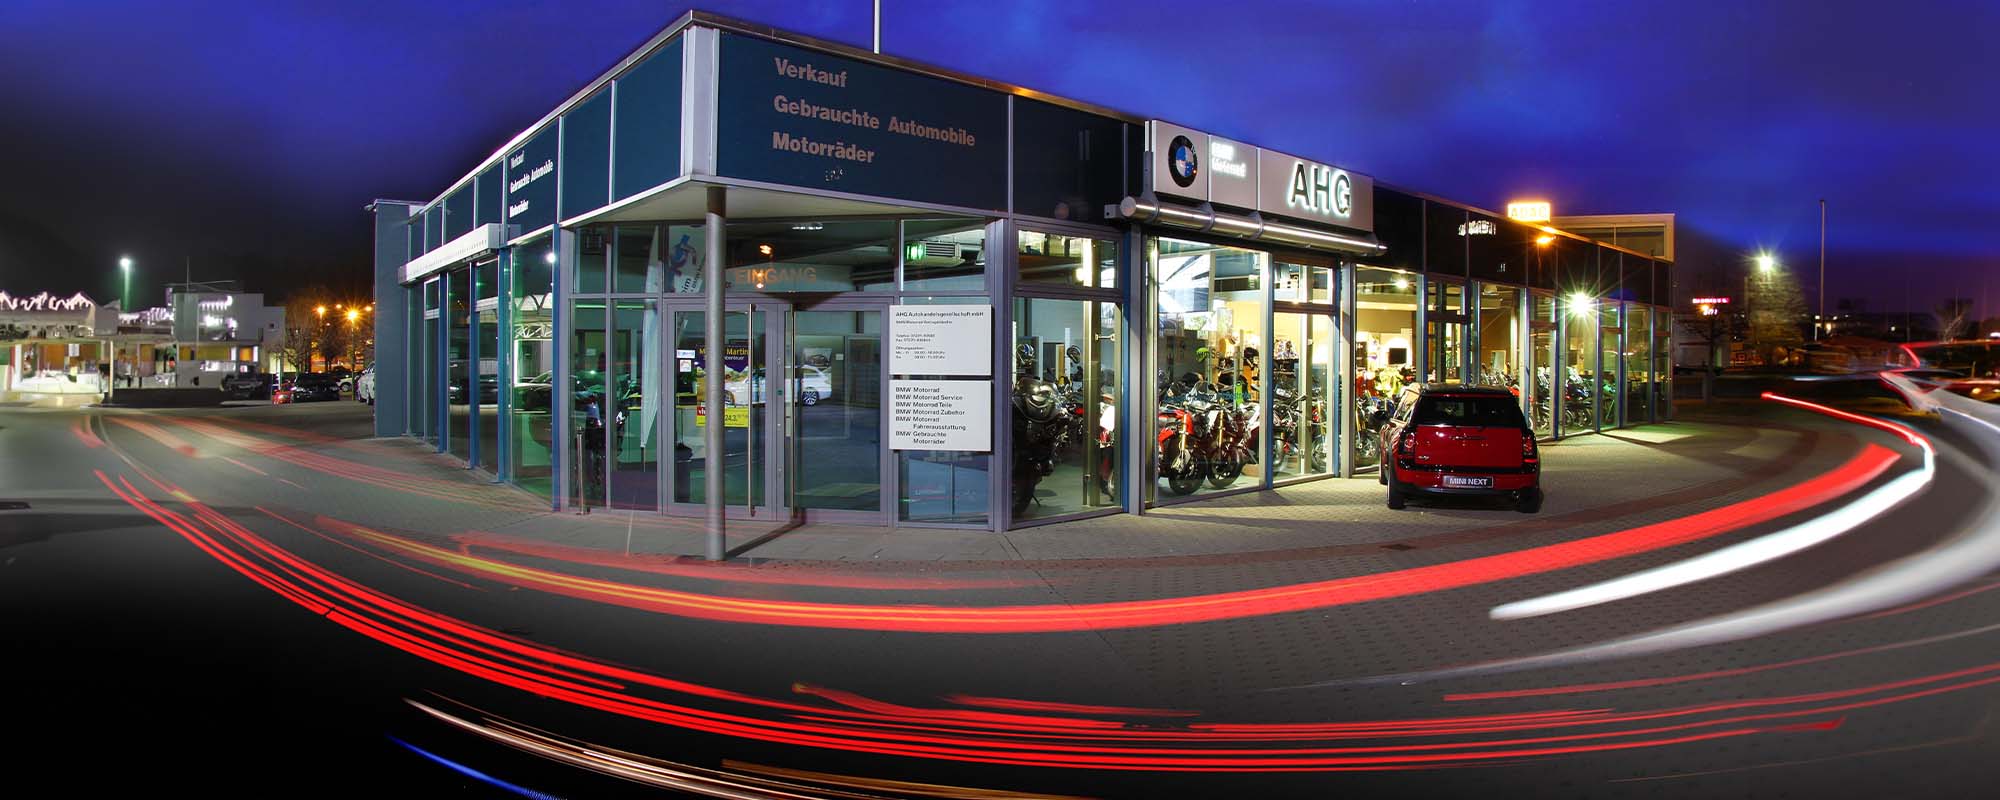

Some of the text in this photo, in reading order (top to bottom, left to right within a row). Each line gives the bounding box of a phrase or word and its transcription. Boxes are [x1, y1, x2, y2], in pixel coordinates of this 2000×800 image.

[774, 57, 848, 88] Verkauf
[773, 95, 976, 147] Gebrauchte Automobile
[772, 131, 875, 163] Motorräder
[1289, 161, 1351, 216] AHG
[735, 267, 817, 285] EINGANG
[913, 423, 967, 431] Fahrerausstattung
[1449, 477, 1488, 486] MINI NEXT
